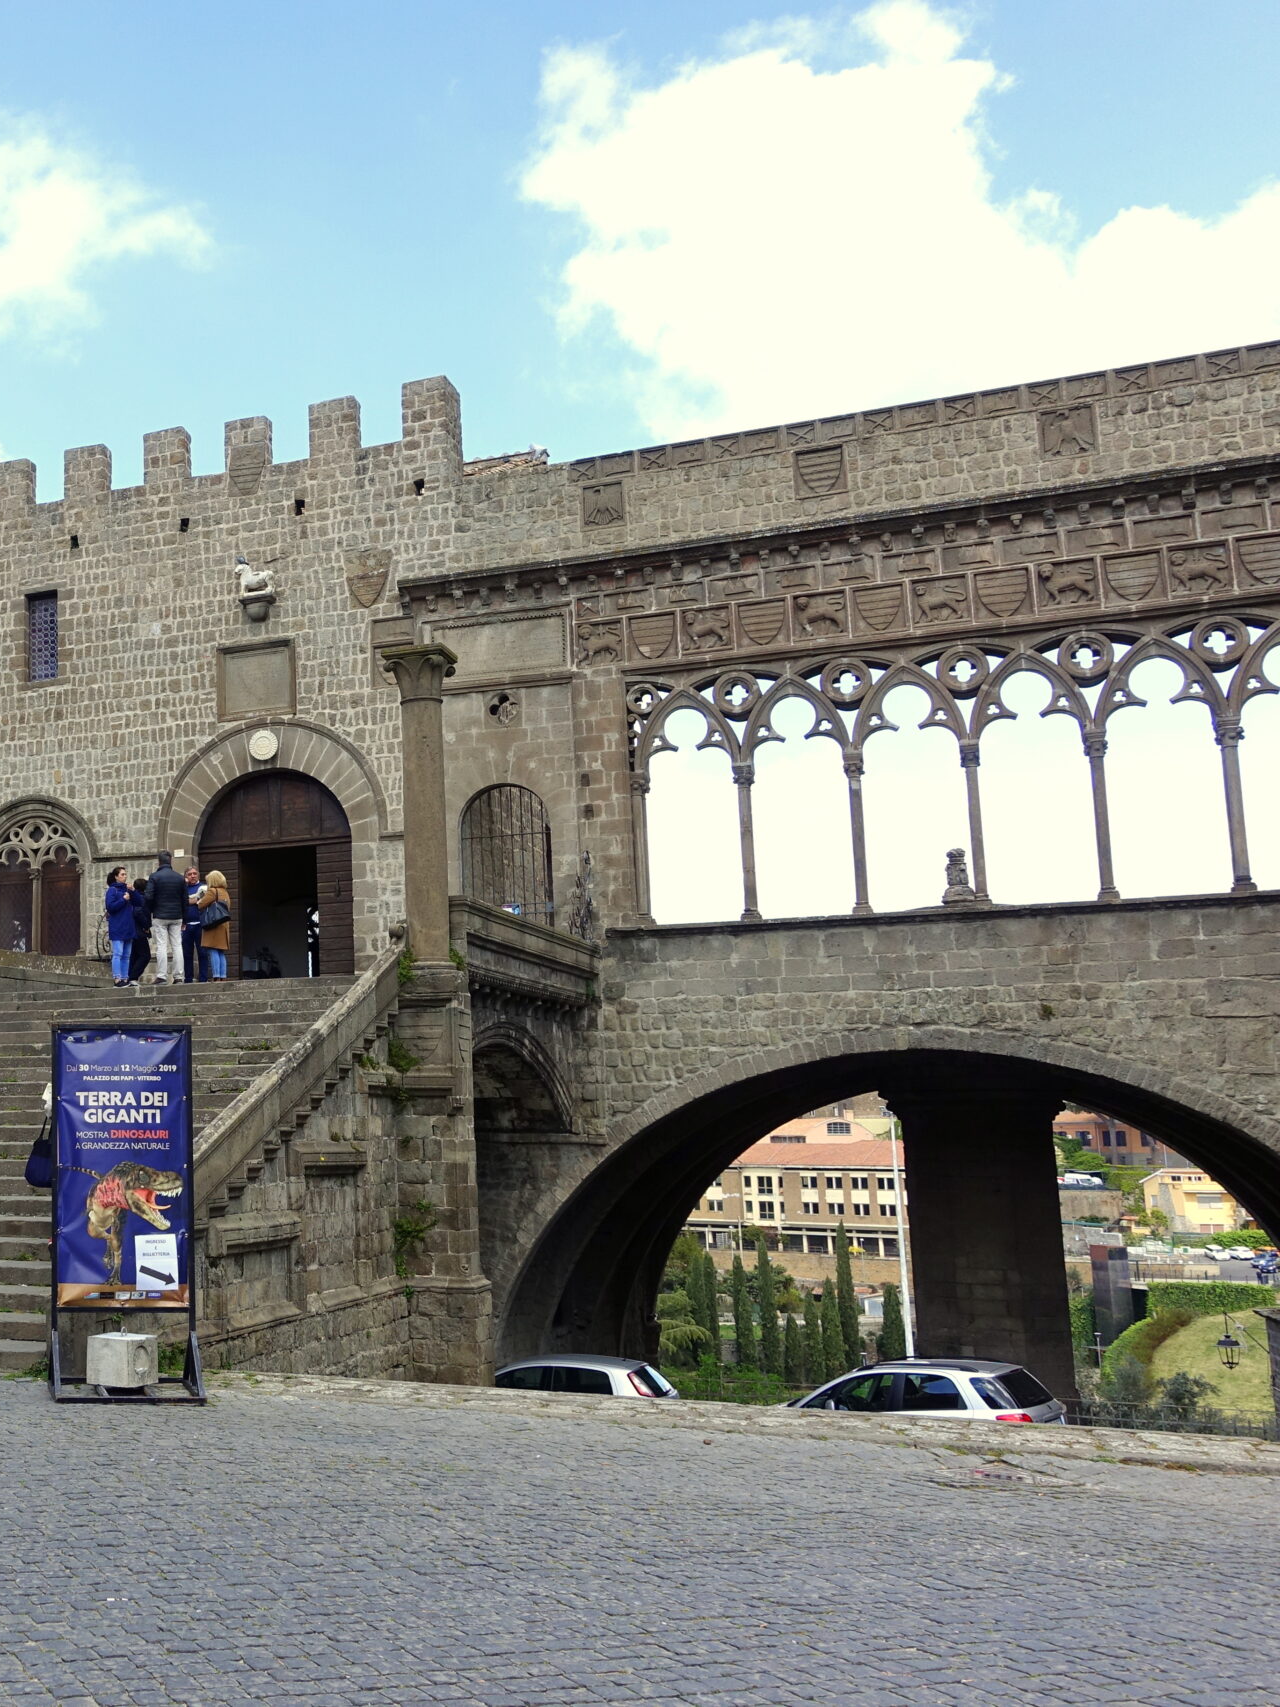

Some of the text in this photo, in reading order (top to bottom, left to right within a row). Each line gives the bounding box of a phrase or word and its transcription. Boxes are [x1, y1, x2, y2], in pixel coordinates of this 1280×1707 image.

[131, 1064, 157, 1073] Maggio
[76, 1092, 168, 1106] TERRA DEI
[84, 1108, 160, 1124] GIGANTI
[111, 1130, 169, 1138] DINOSAURI
